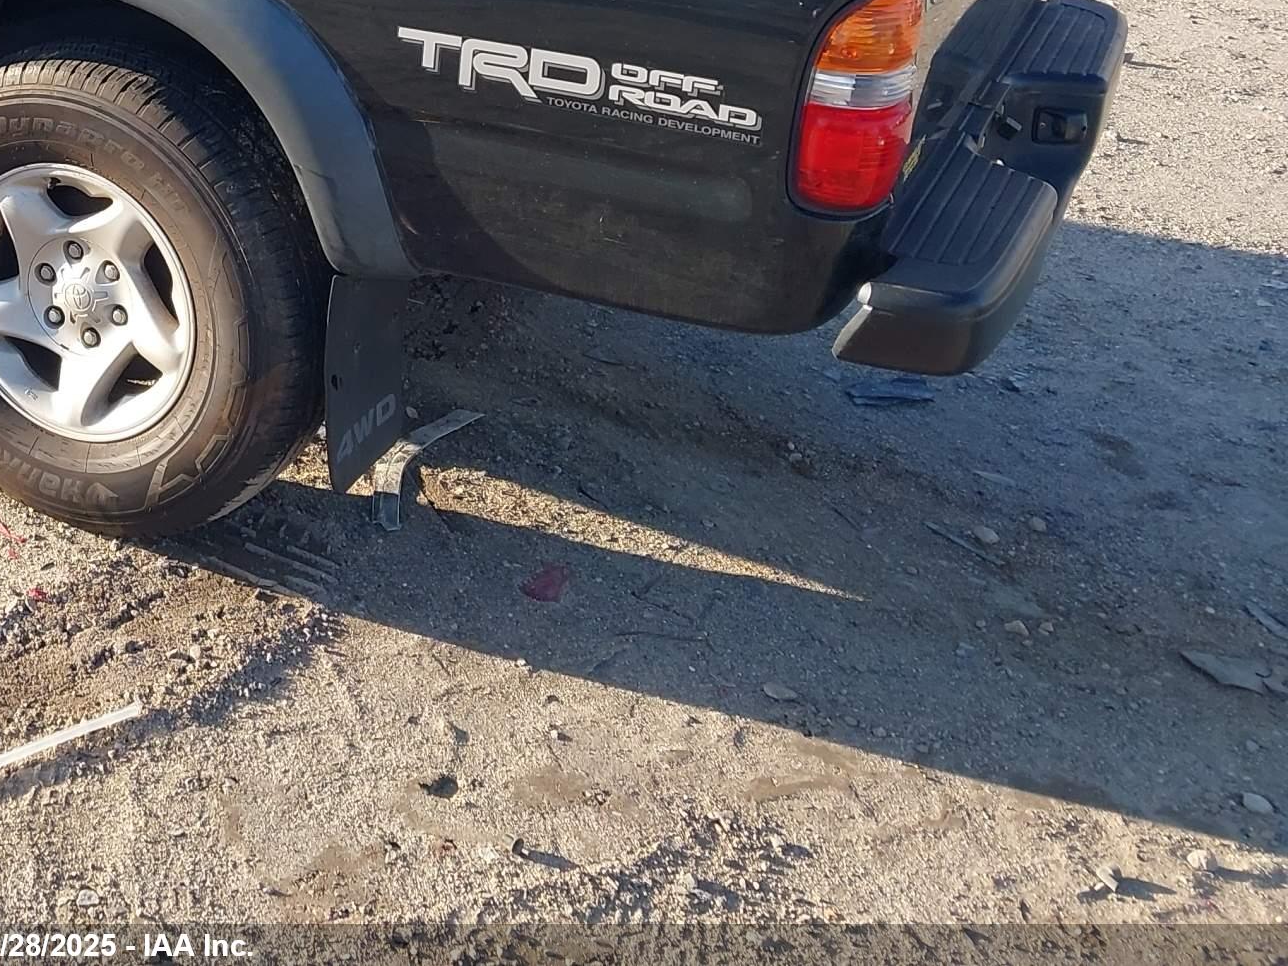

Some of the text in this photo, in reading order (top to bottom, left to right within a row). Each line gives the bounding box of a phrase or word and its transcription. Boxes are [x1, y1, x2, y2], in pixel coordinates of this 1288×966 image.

[398, 26, 724, 103] TRD OFF
[546, 95, 763, 145] TOYOTA RACING DEVELOPMENT
[608, 84, 763, 131] ROAD
[336, 392, 397, 465] 4WD
